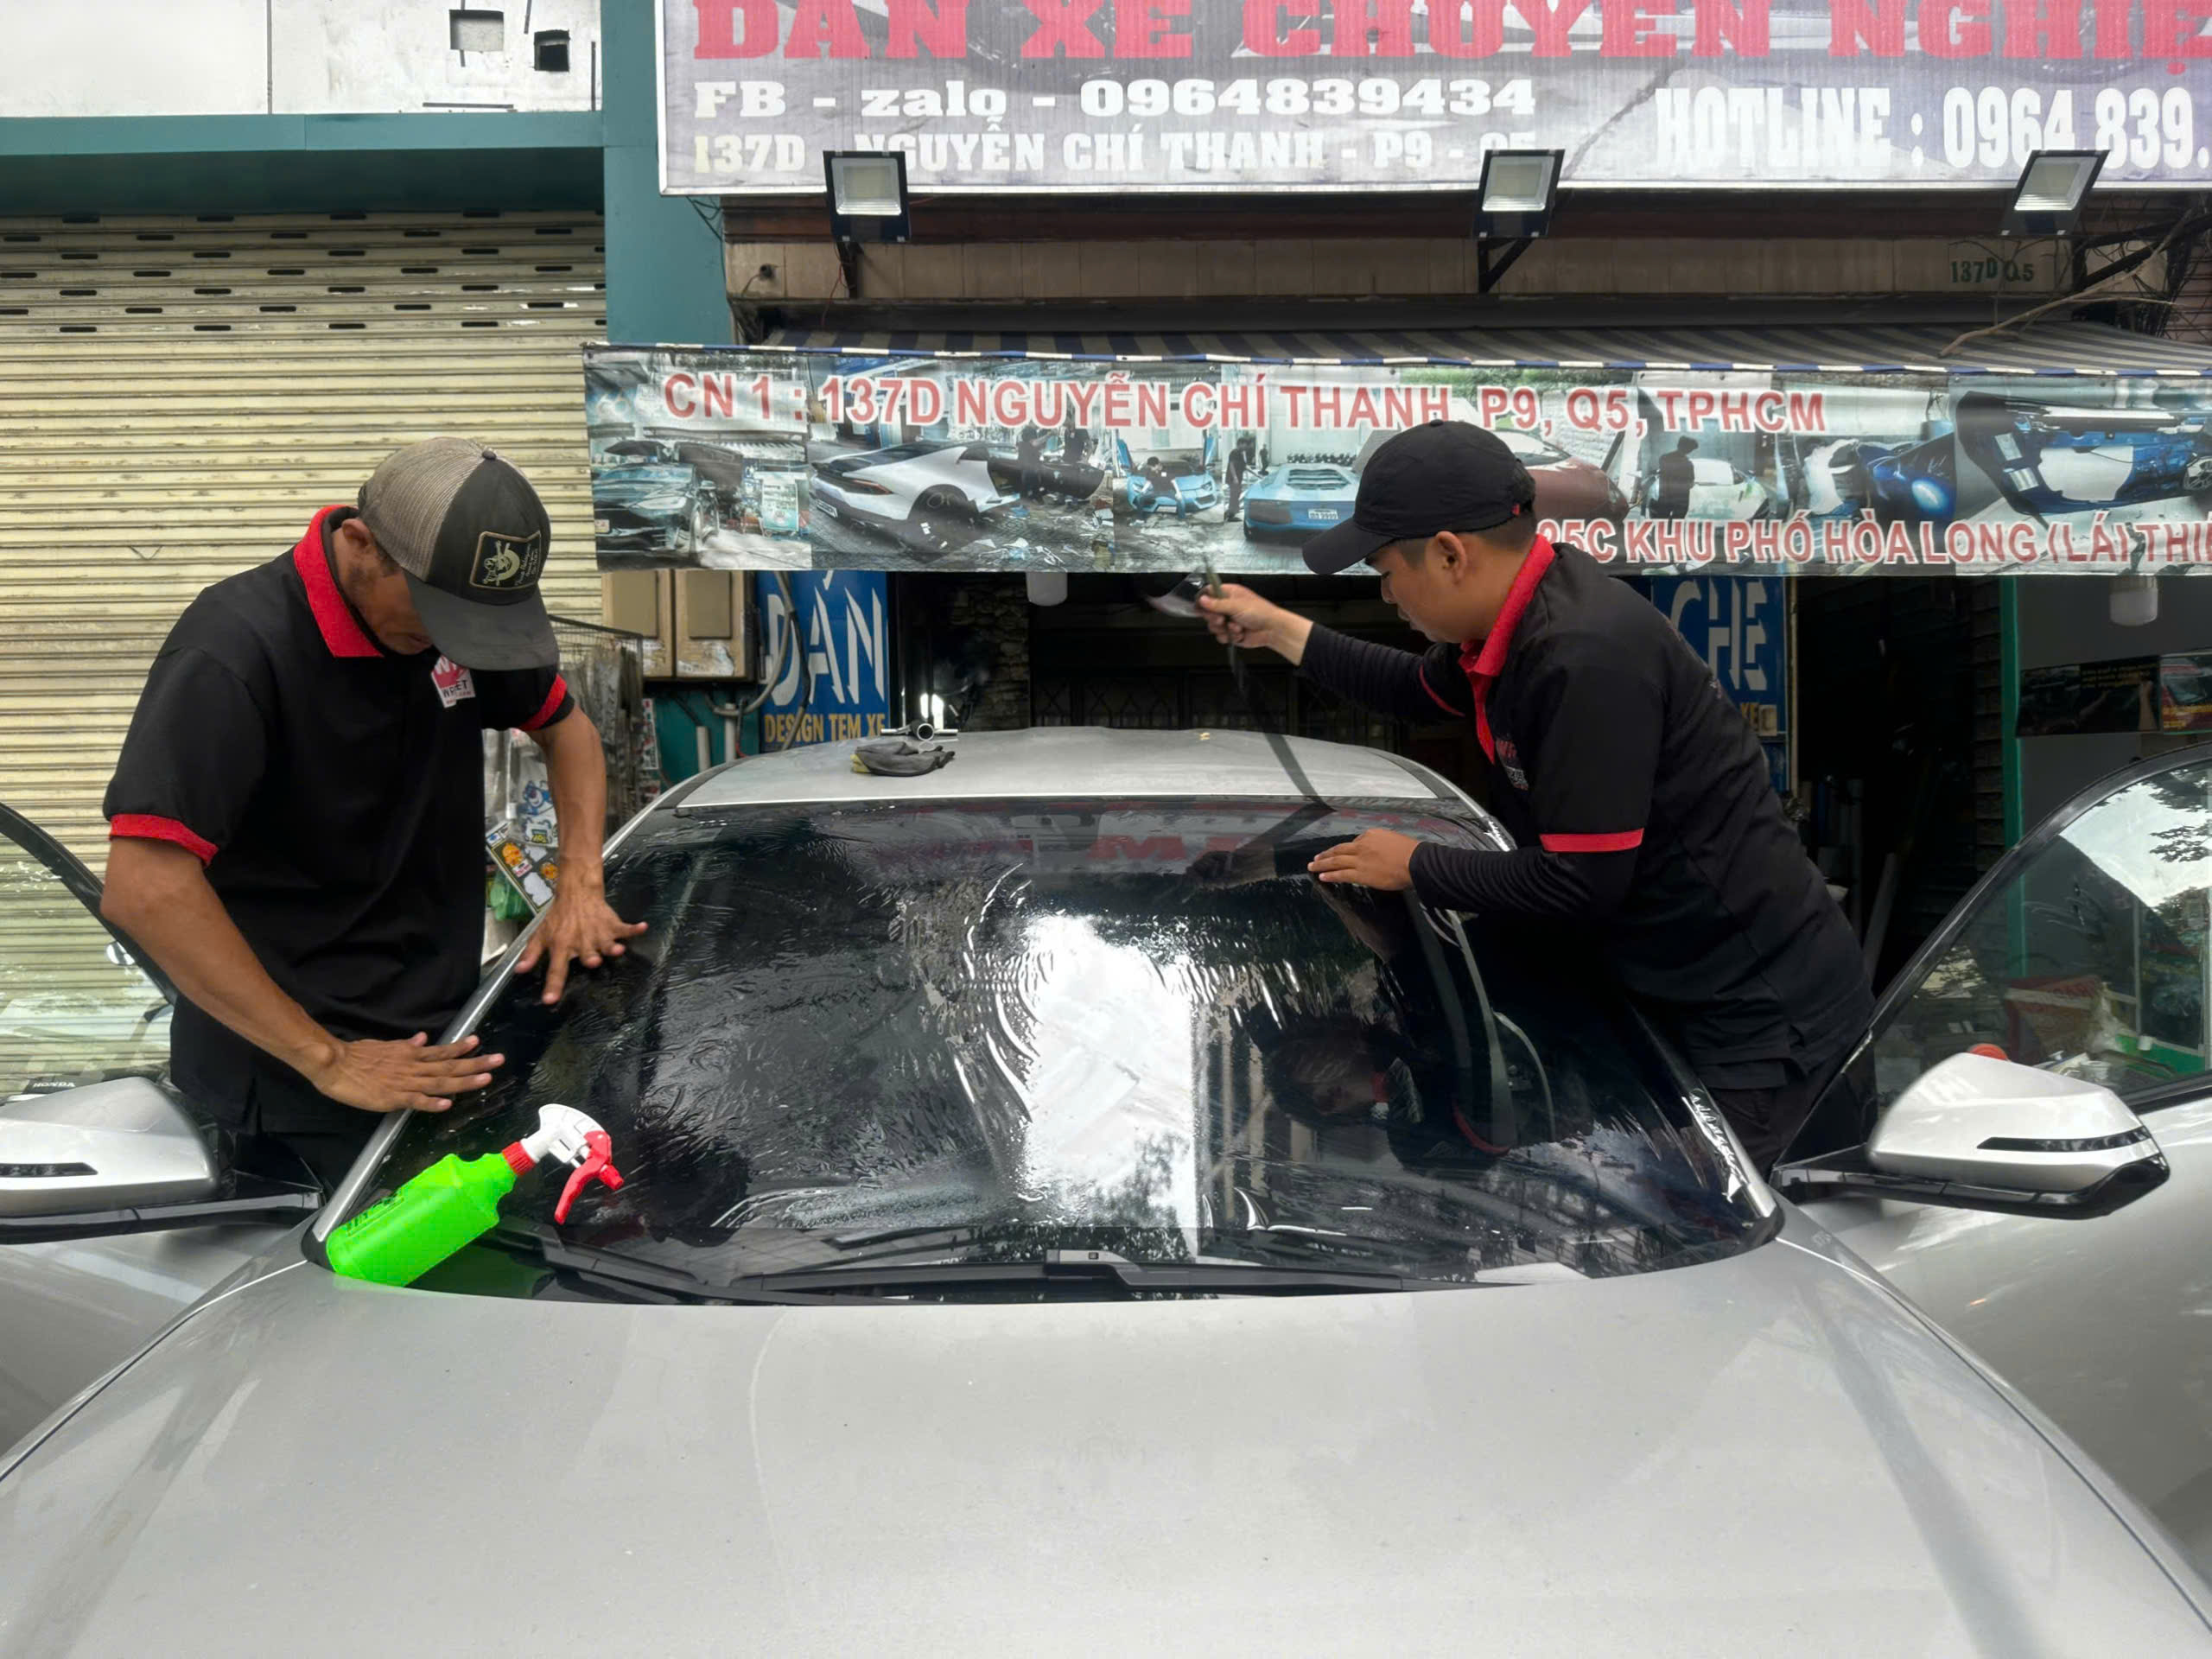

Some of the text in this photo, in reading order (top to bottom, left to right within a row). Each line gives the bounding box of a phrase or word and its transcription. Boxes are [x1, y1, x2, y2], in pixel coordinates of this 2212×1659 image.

[1021, 0, 1192, 59] XE
[694, 81, 786, 118] FB
[861, 80, 1007, 117] zalo
[1080, 79, 1535, 117] 0964839434
[694, 135, 805, 172] 137D
[1062, 125, 1146, 171] CHÍ
[1160, 132, 1325, 169] THANH
[1374, 131, 1432, 168] P9
[1656, 87, 1891, 168] HOTLINE
[1942, 86, 2075, 168] 0964
[1949, 257, 1998, 283] 137D
[664, 373, 734, 418] CN
[750, 375, 771, 419] 1
[818, 376, 941, 424] 137D
[957, 372, 1166, 429] NGUYỄN
[1183, 373, 1268, 429] CHÍ
[1280, 385, 1450, 429] THANH
[1481, 387, 1553, 436] P9,
[1566, 388, 1647, 437] Q5,
[1656, 390, 1826, 432] TPHCM
[1626, 520, 1714, 563] KHU
[1727, 512, 1813, 562] PHỐ
[1824, 509, 1916, 562] HÒA
[1921, 524, 2037, 563] LONG
[829, 713, 861, 741] TEM
